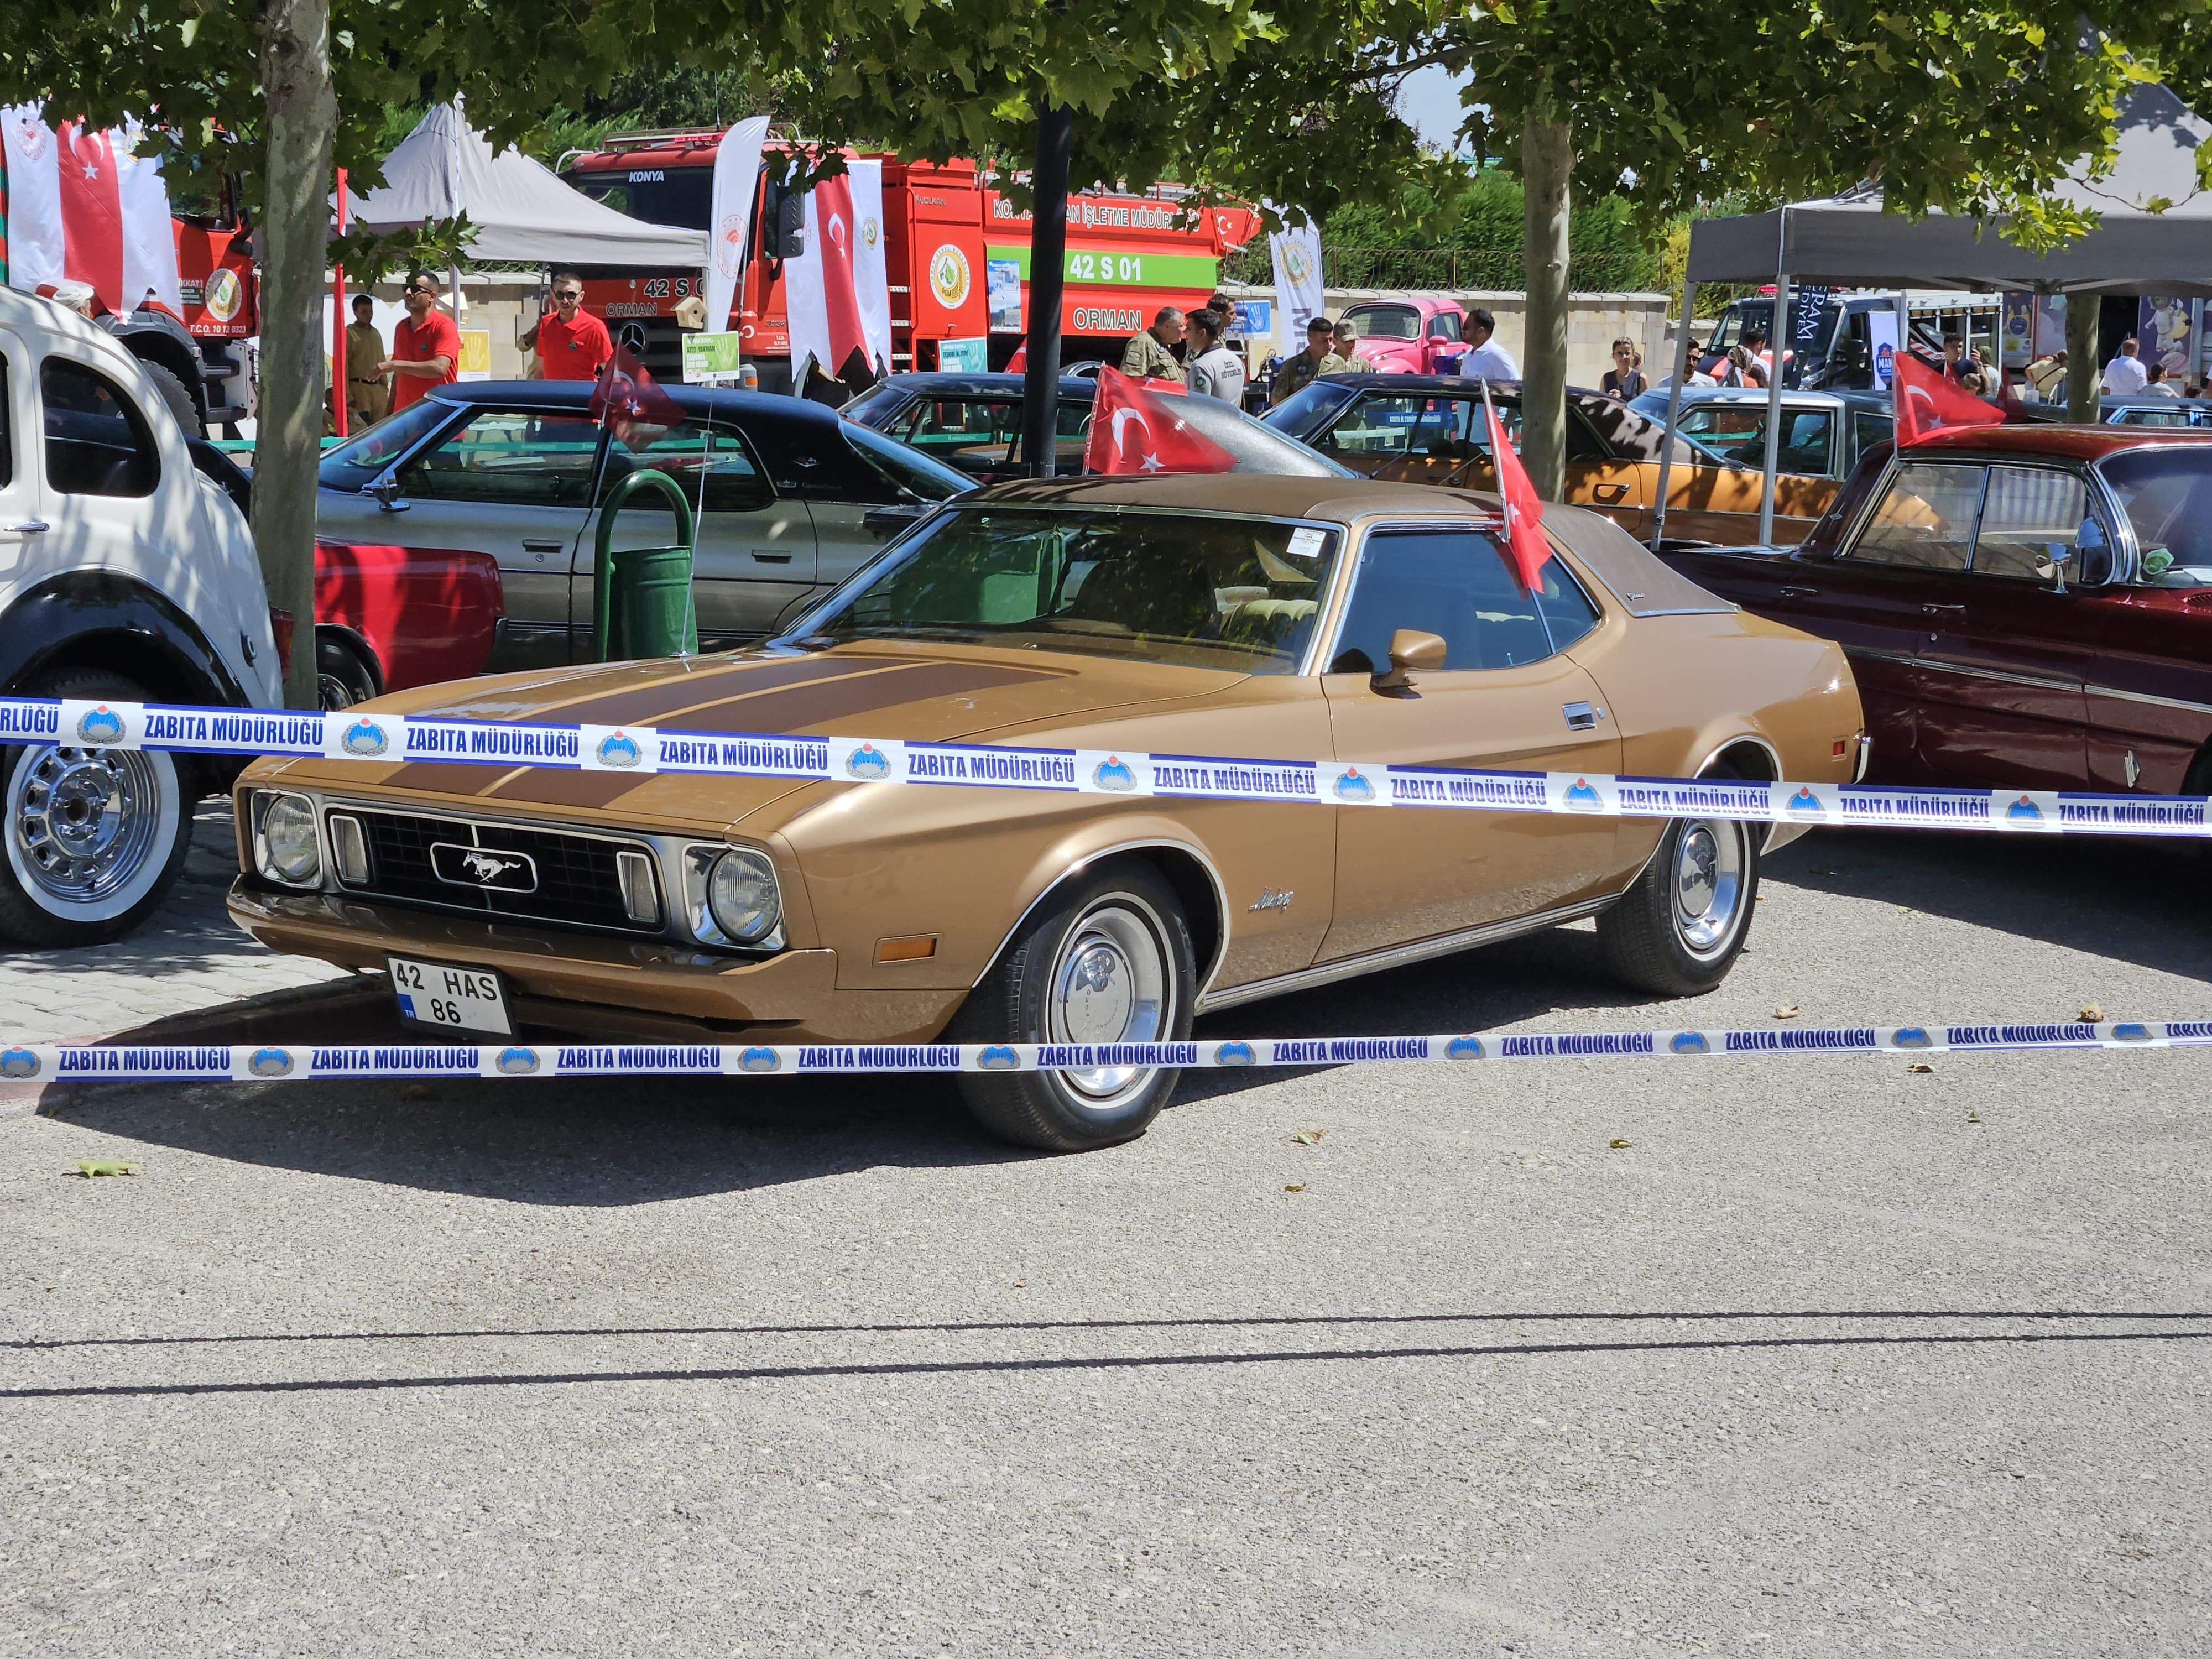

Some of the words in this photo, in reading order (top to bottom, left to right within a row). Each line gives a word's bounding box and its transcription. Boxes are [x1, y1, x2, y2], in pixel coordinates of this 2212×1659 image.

[629, 170, 664, 182] KONYA
[1082, 201, 1129, 228] İŞLETME
[1131, 206, 1200, 232] MÜDÜR
[1070, 254, 1095, 279] 42
[1100, 256, 1114, 280] S
[1119, 257, 1141, 281] 01
[643, 279, 669, 298] 42
[675, 278, 690, 297] S
[606, 302, 658, 317] ORMAN
[1073, 307, 1142, 331] ORMAN
[190, 324, 210, 333] T.C.O.
[212, 325, 221, 333] 10
[145, 715, 207, 741] ZABITA
[212, 717, 323, 746] MÜDÜRLÜĞÜ
[406, 727, 467, 753] ZABITA
[472, 729, 578, 758] MÜDÜRLÜĞÜ
[660, 740, 718, 765] ZABITA
[723, 741, 828, 771] MÜDÜRLÜĞÜ
[908, 754, 967, 777] ZABITA
[971, 754, 1075, 783] MÜDÜRLÜĞÜ
[1153, 767, 1212, 789] ZABITA
[1214, 766, 1316, 794] MÜDÜRLÜĞÜ
[1391, 779, 1448, 800] ZABITA
[1449, 778, 1547, 805] MÜDÜRLÜĞÜ
[1618, 789, 1673, 811] ZABITA
[1674, 787, 1771, 815] MÜDÜRLÜĞÜ
[397, 963, 425, 990] 42
[443, 971, 497, 1001] HAS
[405, 1010, 415, 1018] TR
[431, 998, 461, 1024] 86
[1501, 1036, 1556, 1056] ZABITA
[1557, 1032, 1653, 1054] MÜDÜRLÜĞÜ
[1725, 1031, 1779, 1050] ZABITA
[1947, 1027, 2001, 1044] ZABITA
[59, 1050, 119, 1071] ZABITA
[123, 1048, 231, 1071] MÜDÜRLÜĞÜ
[311, 1049, 370, 1070] ZABITA
[374, 1047, 478, 1070] MÜDÜRLÜĞÜ
[557, 1048, 614, 1068] ZABITA
[618, 1047, 720, 1068] MÜDÜRLÜĞÜ
[798, 1048, 855, 1067] ZABITA
[858, 1046, 960, 1067] MÜDÜRLÜĞÜ
[1037, 1046, 1094, 1066] ZABITA
[1098, 1044, 1198, 1065] MÜDÜRLÜĞÜ
[1273, 1042, 1328, 1061] ZABITA
[1331, 1037, 1428, 1060] MÜDÜRLÜĞÜ
